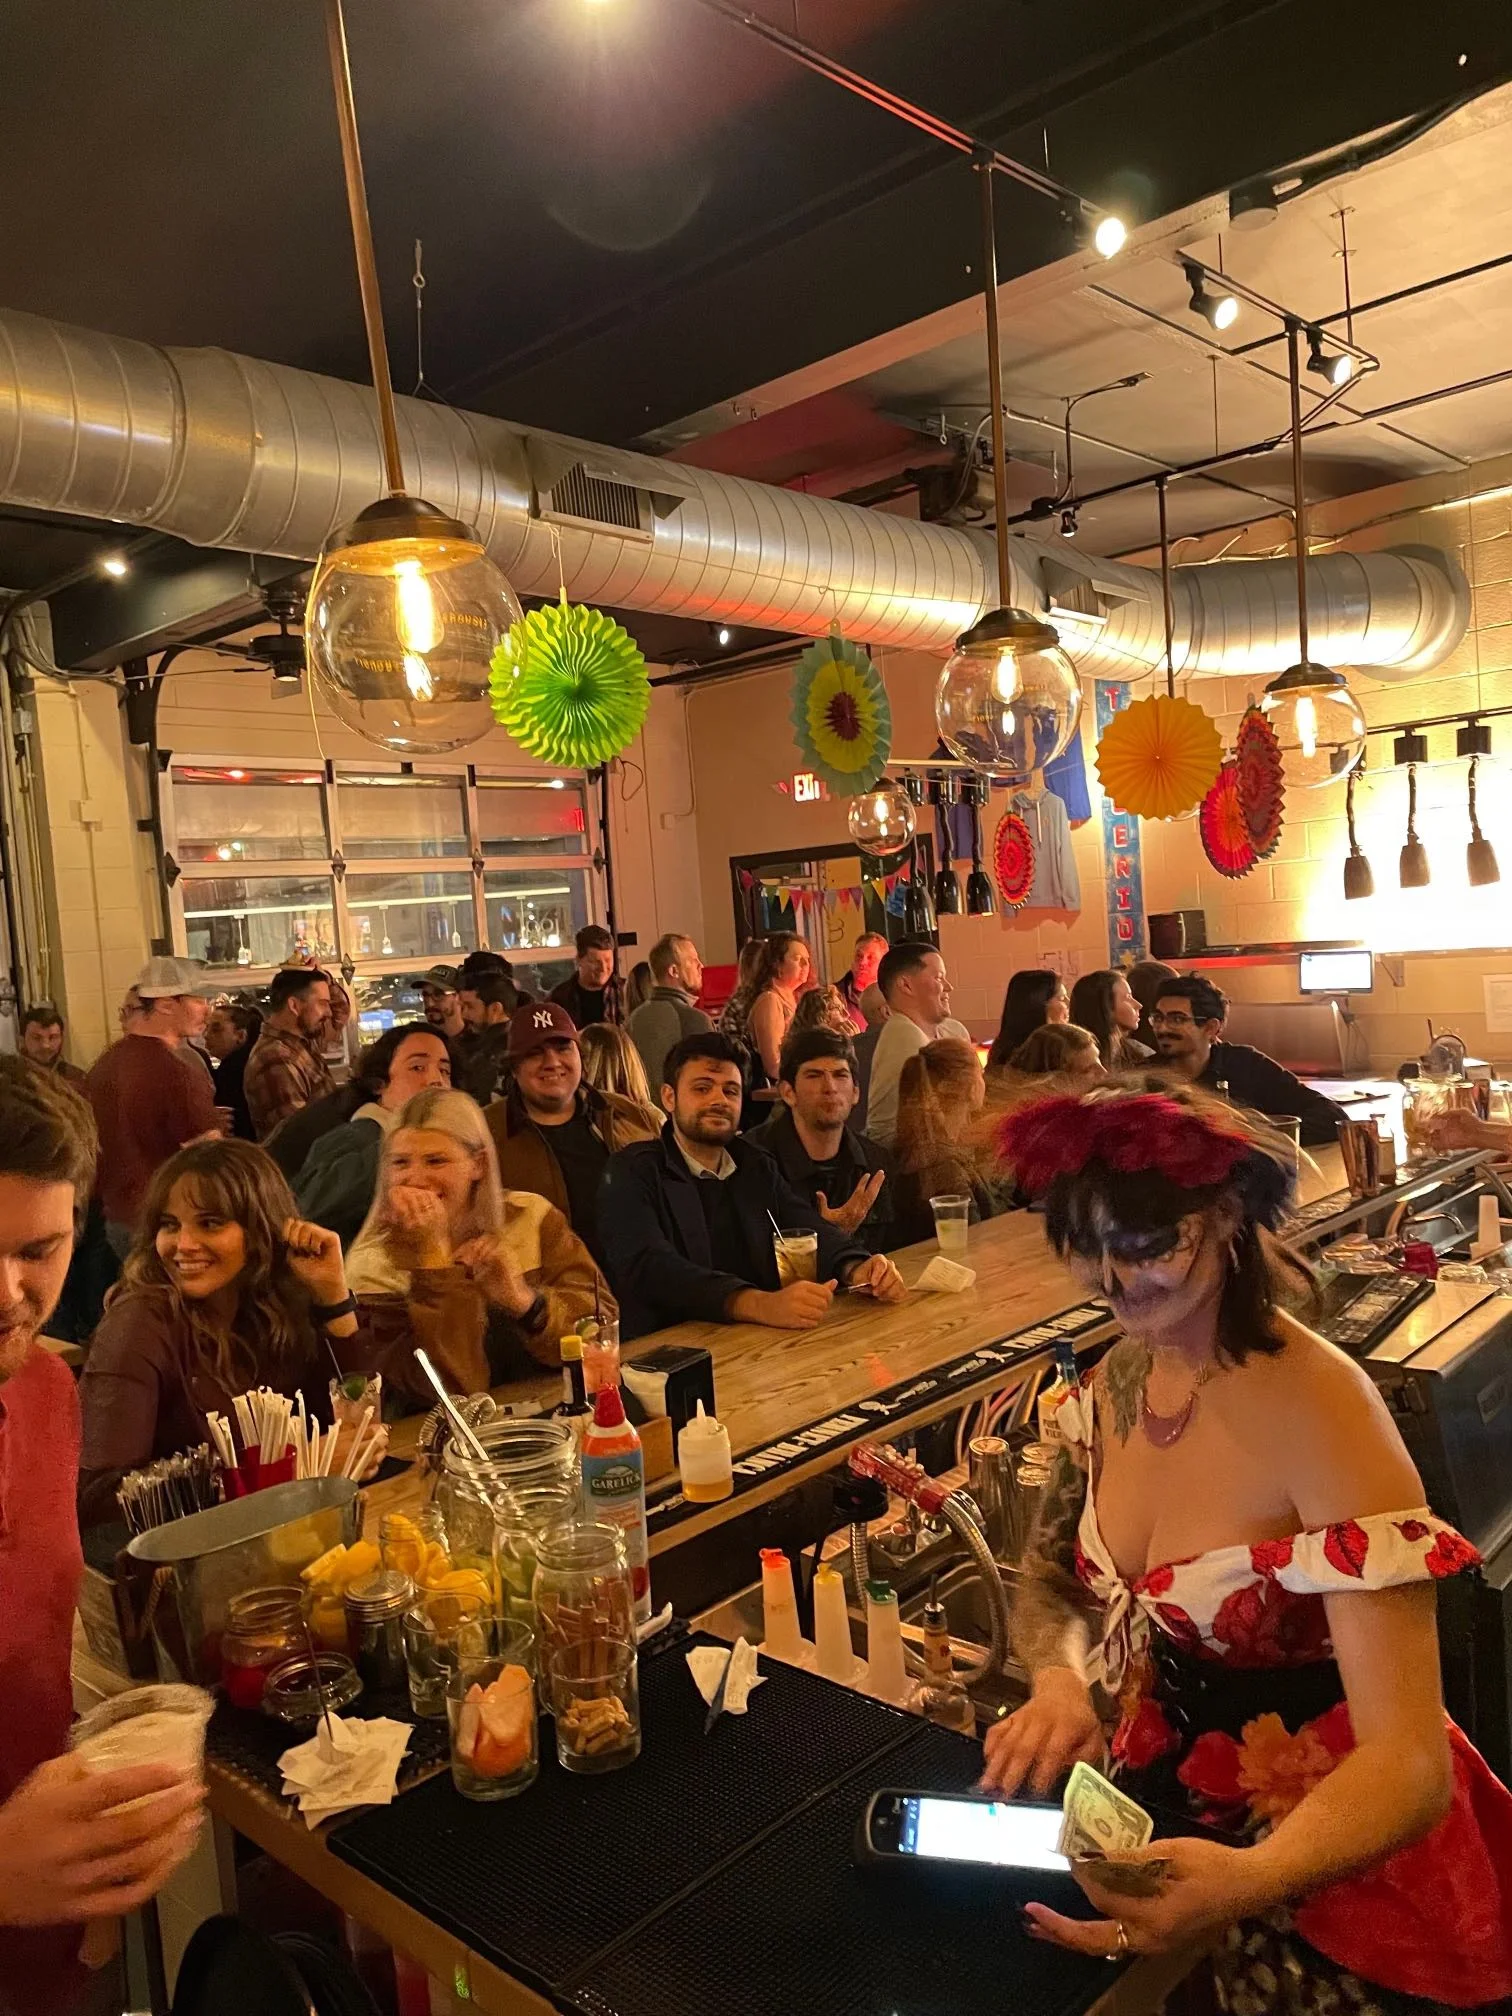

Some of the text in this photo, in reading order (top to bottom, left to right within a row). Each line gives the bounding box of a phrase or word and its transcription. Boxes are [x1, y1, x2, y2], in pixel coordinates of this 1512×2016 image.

[793, 773, 823, 802] EXI
[532, 1010, 554, 1028] NY
[591, 1473, 641, 1489] GARELICK
